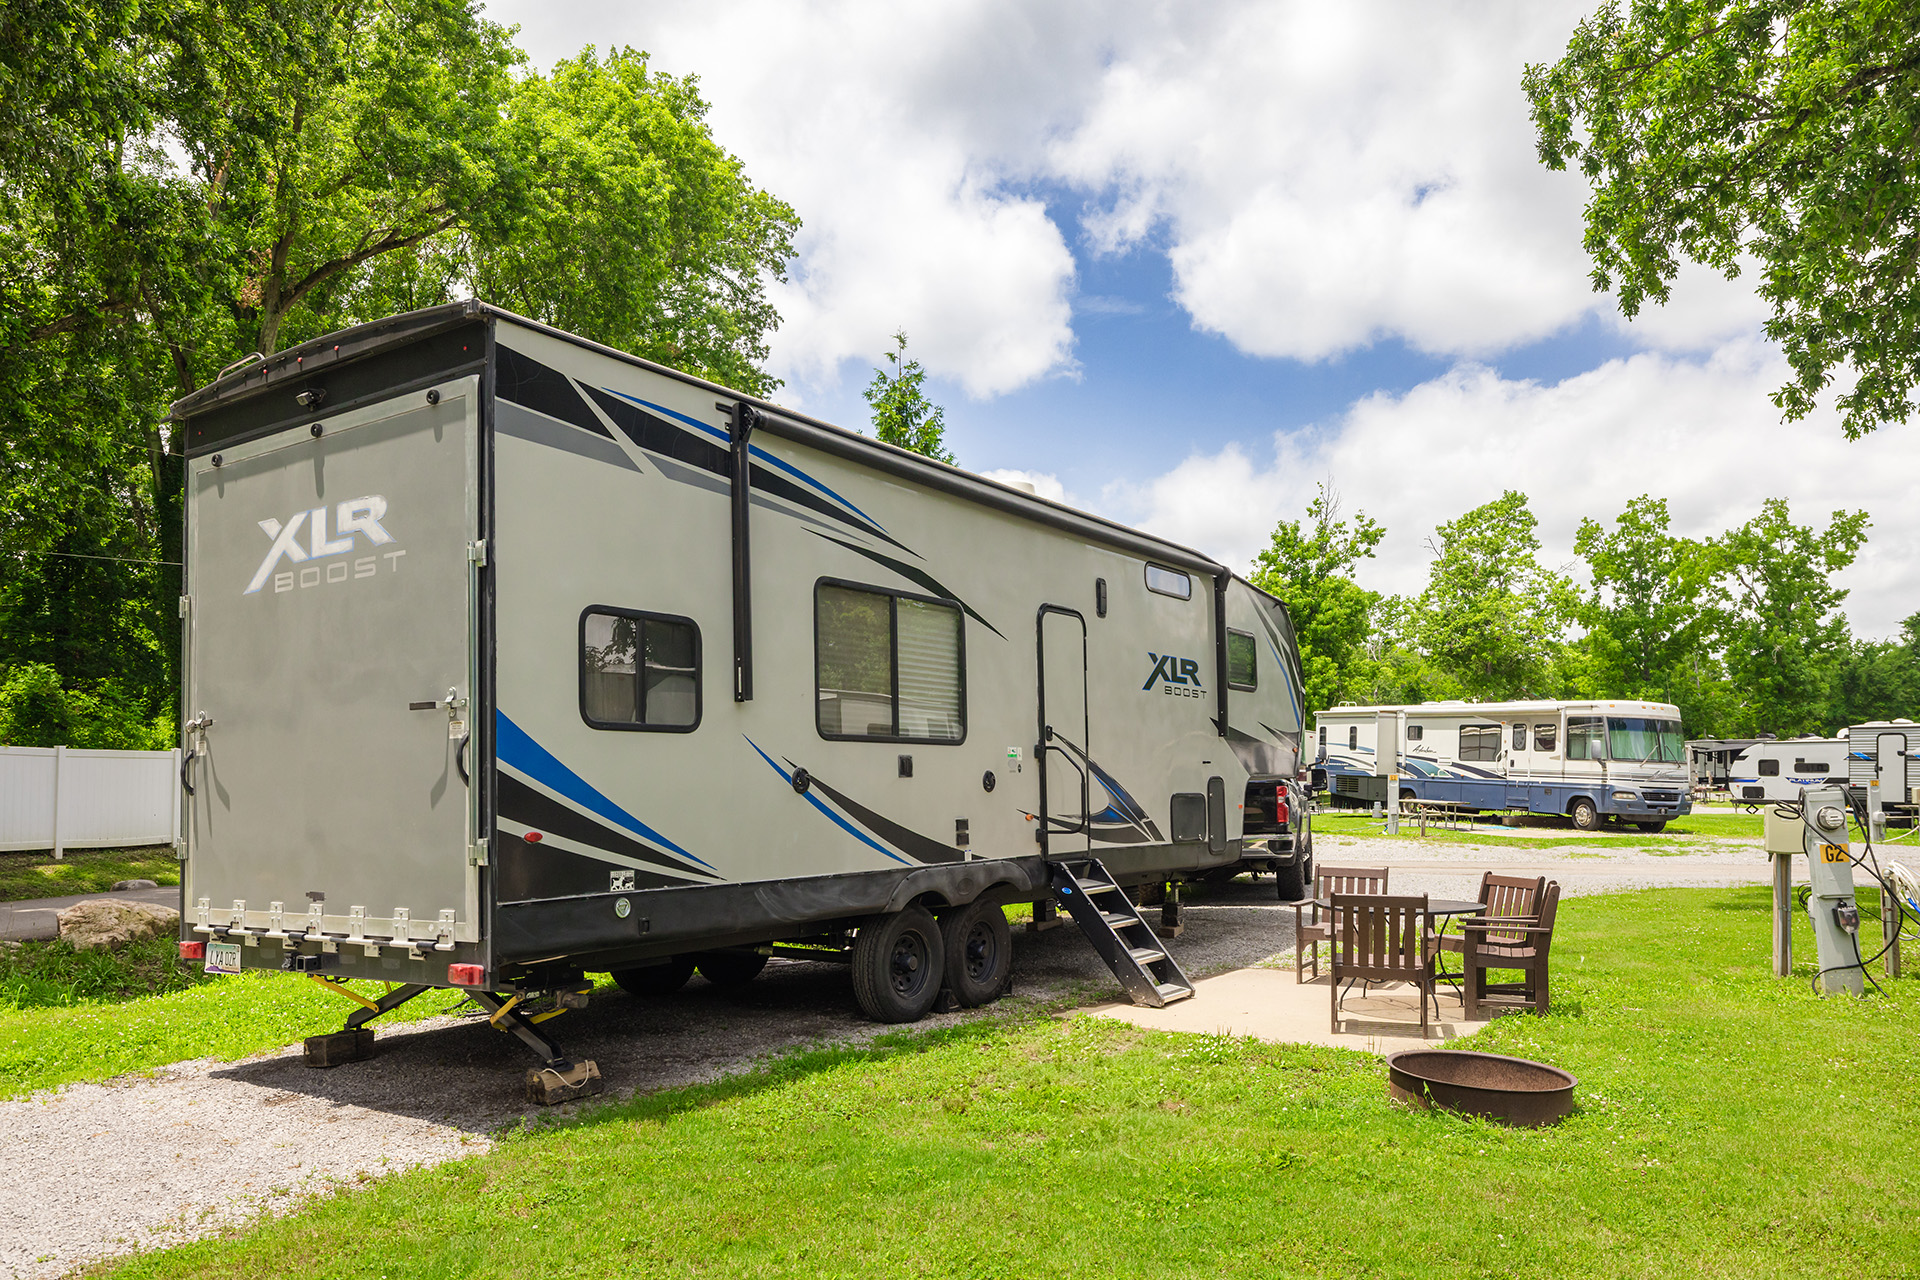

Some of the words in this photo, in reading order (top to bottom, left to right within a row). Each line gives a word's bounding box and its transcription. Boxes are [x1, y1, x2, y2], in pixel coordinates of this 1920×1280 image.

[243, 494, 397, 595] XLR
[274, 550, 406, 593] BOOST
[1142, 652, 1202, 691] XLR
[1164, 685, 1207, 699] BOOST
[1825, 845, 1844, 862] G2
